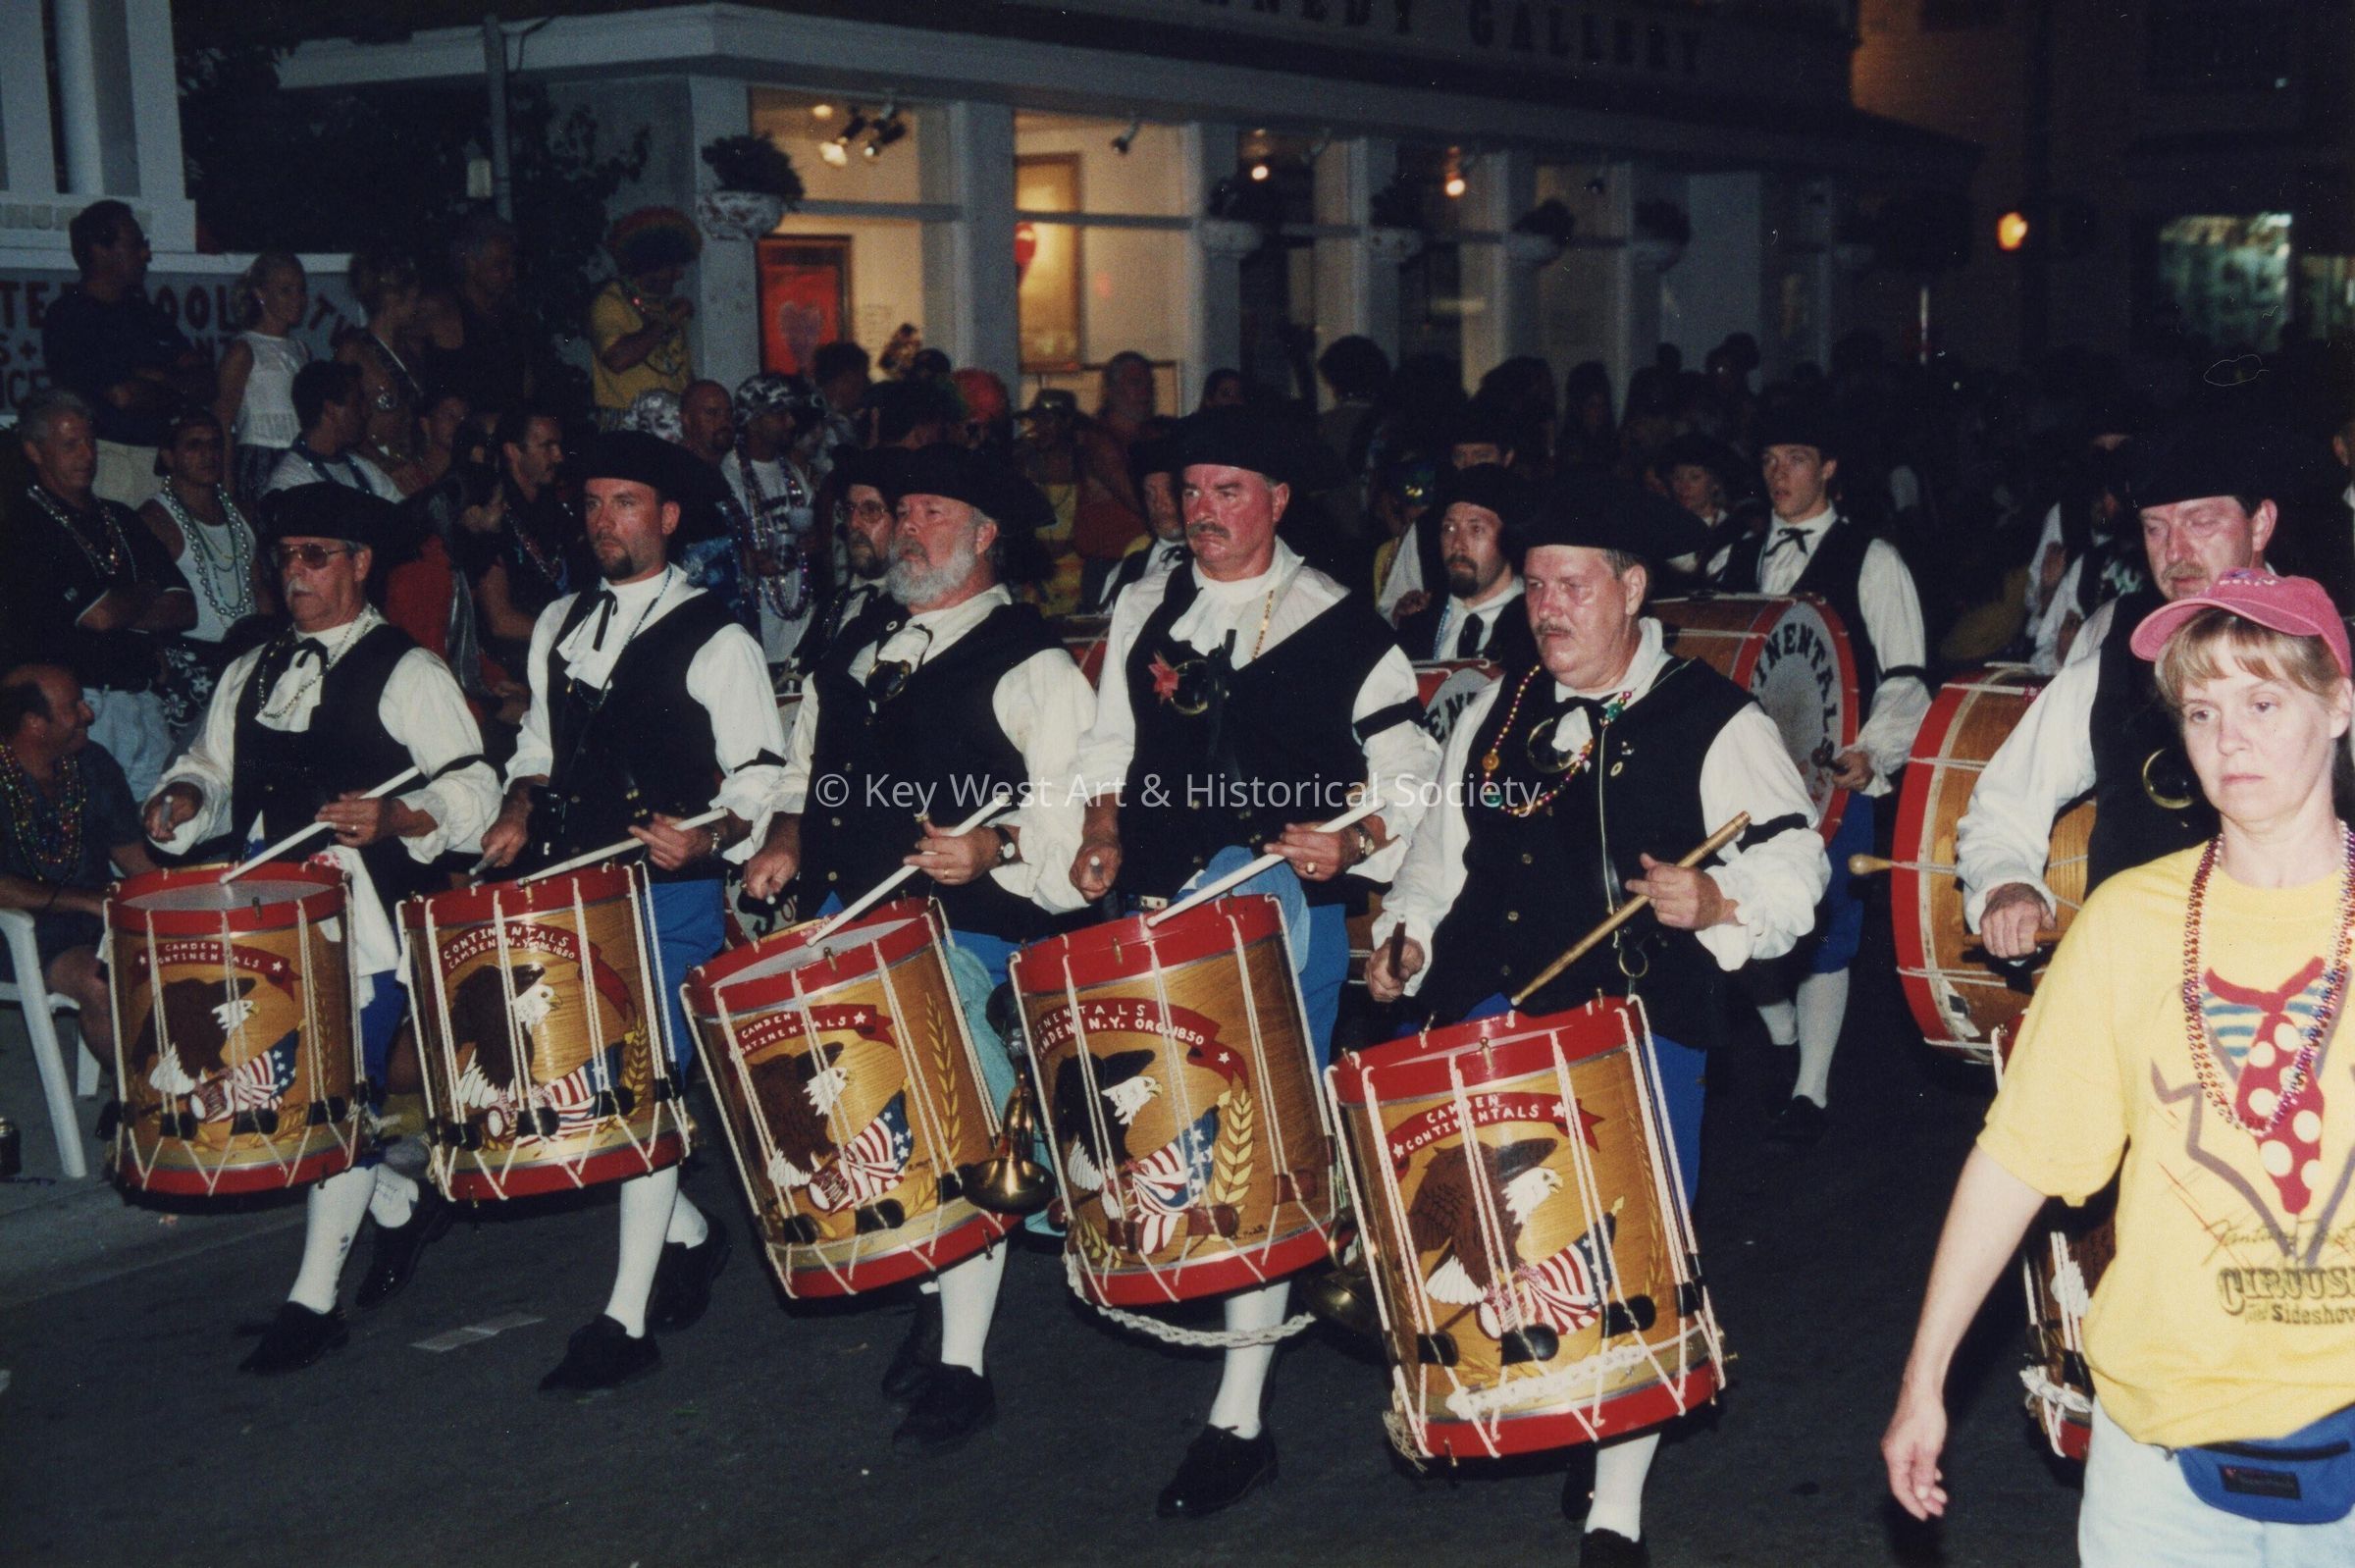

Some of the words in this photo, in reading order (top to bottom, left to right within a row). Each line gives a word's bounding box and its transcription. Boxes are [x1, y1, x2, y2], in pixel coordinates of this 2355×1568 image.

[1754, 622, 1837, 759] INENTALS
[165, 942, 219, 952] CAMDEN
[444, 926, 569, 960] CONTINNTALS
[448, 939, 497, 969] CAMDEN
[157, 952, 259, 968] ONTINENALS
[741, 1013, 792, 1039] CAMDEN
[741, 1016, 846, 1056] ONTINENALS
[1088, 1017, 1125, 1029] N.Y.
[1426, 1094, 1499, 1124] CAMEN
[1405, 1104, 1540, 1151] CONTINNTALS
